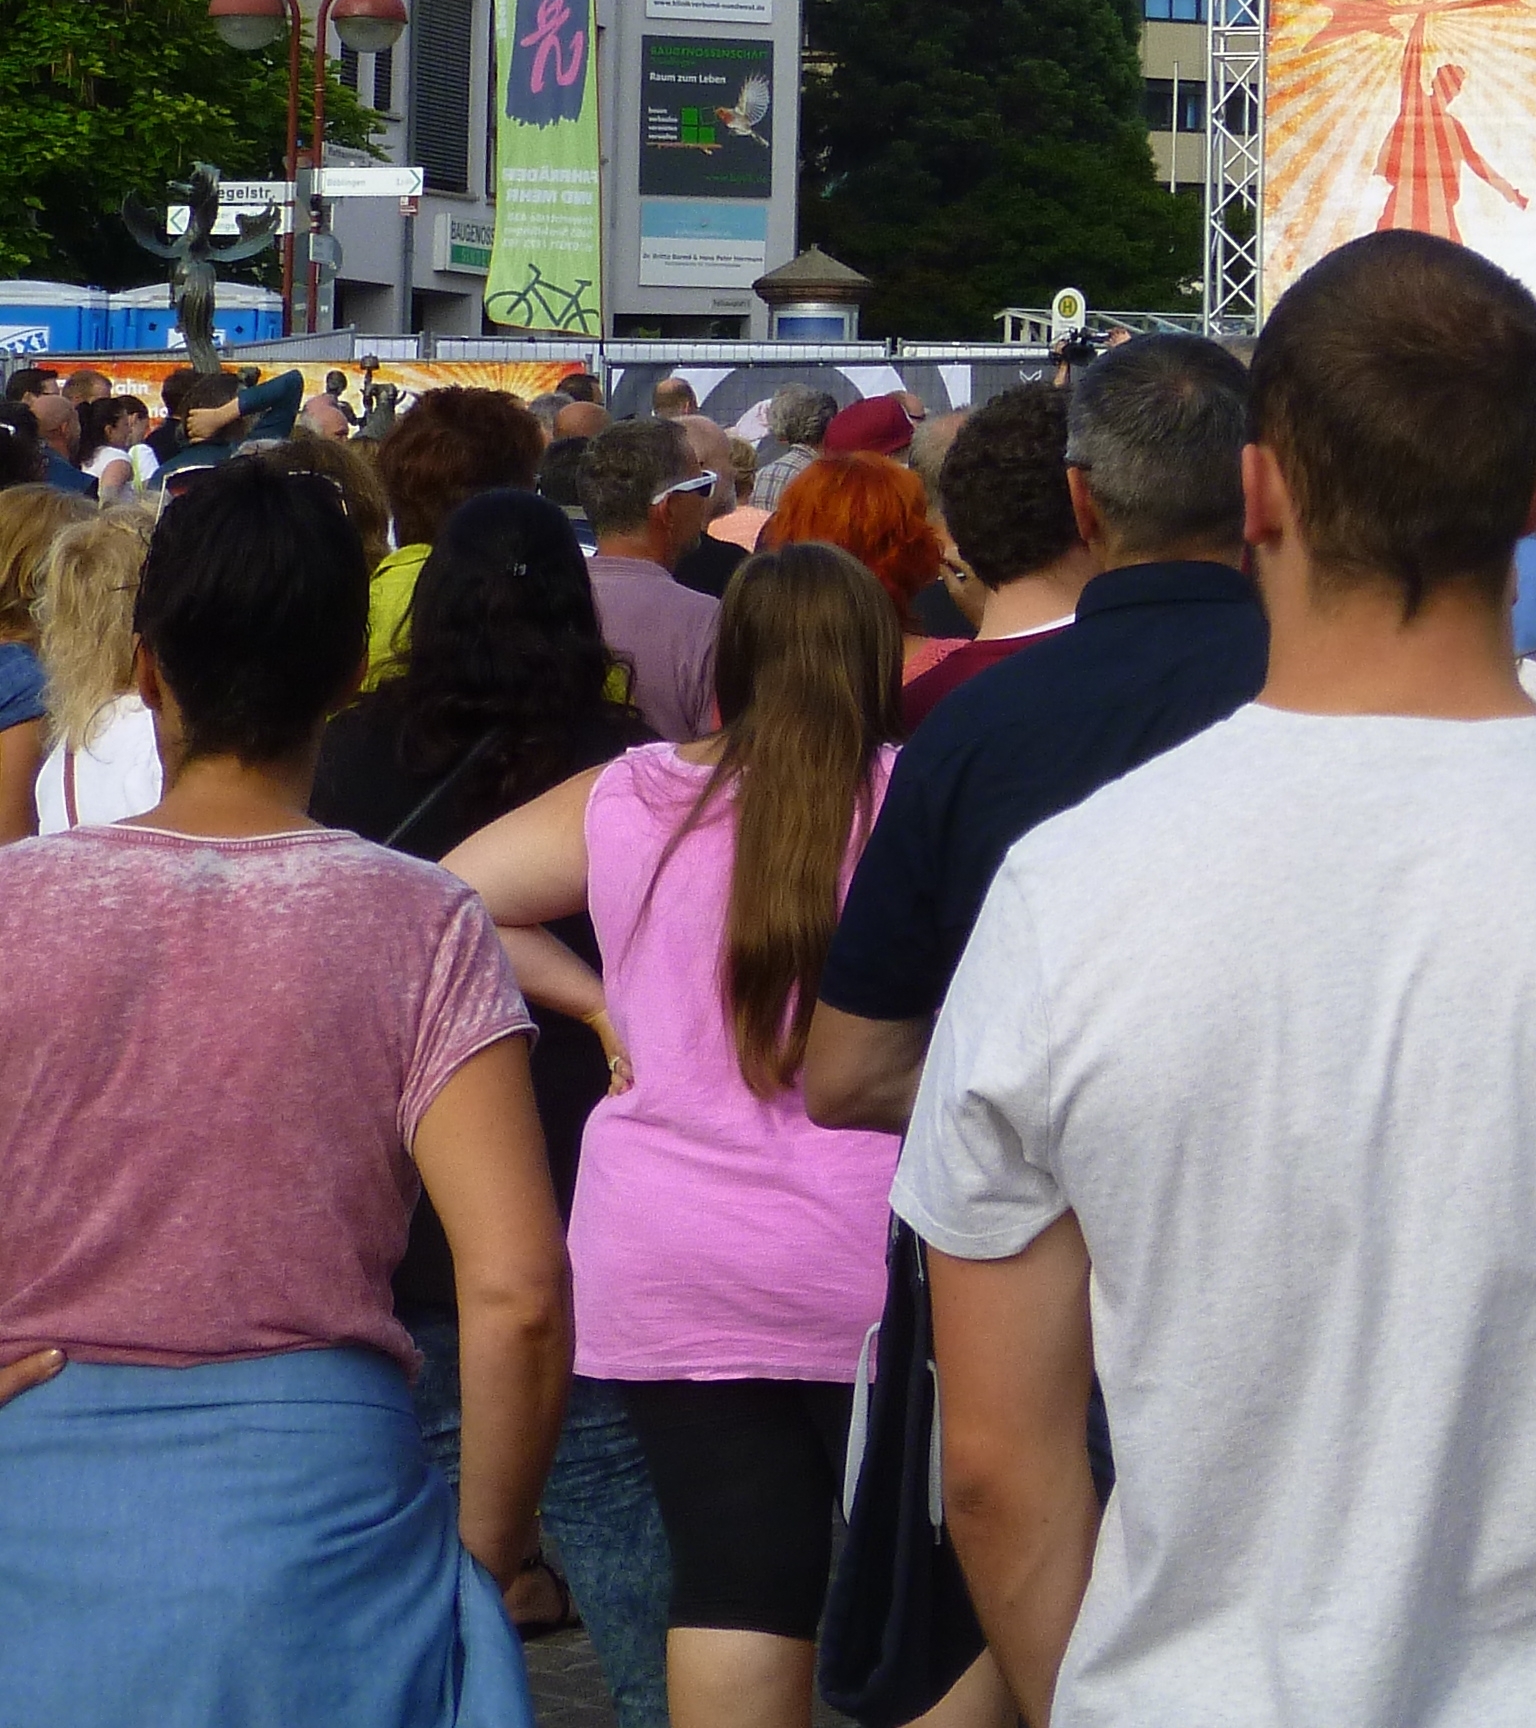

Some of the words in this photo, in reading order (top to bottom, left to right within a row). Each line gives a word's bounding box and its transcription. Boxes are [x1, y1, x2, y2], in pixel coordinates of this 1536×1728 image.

[649, 72, 676, 82] Raum
[677, 75, 697, 83] zum
[699, 74, 727, 84] Leben
